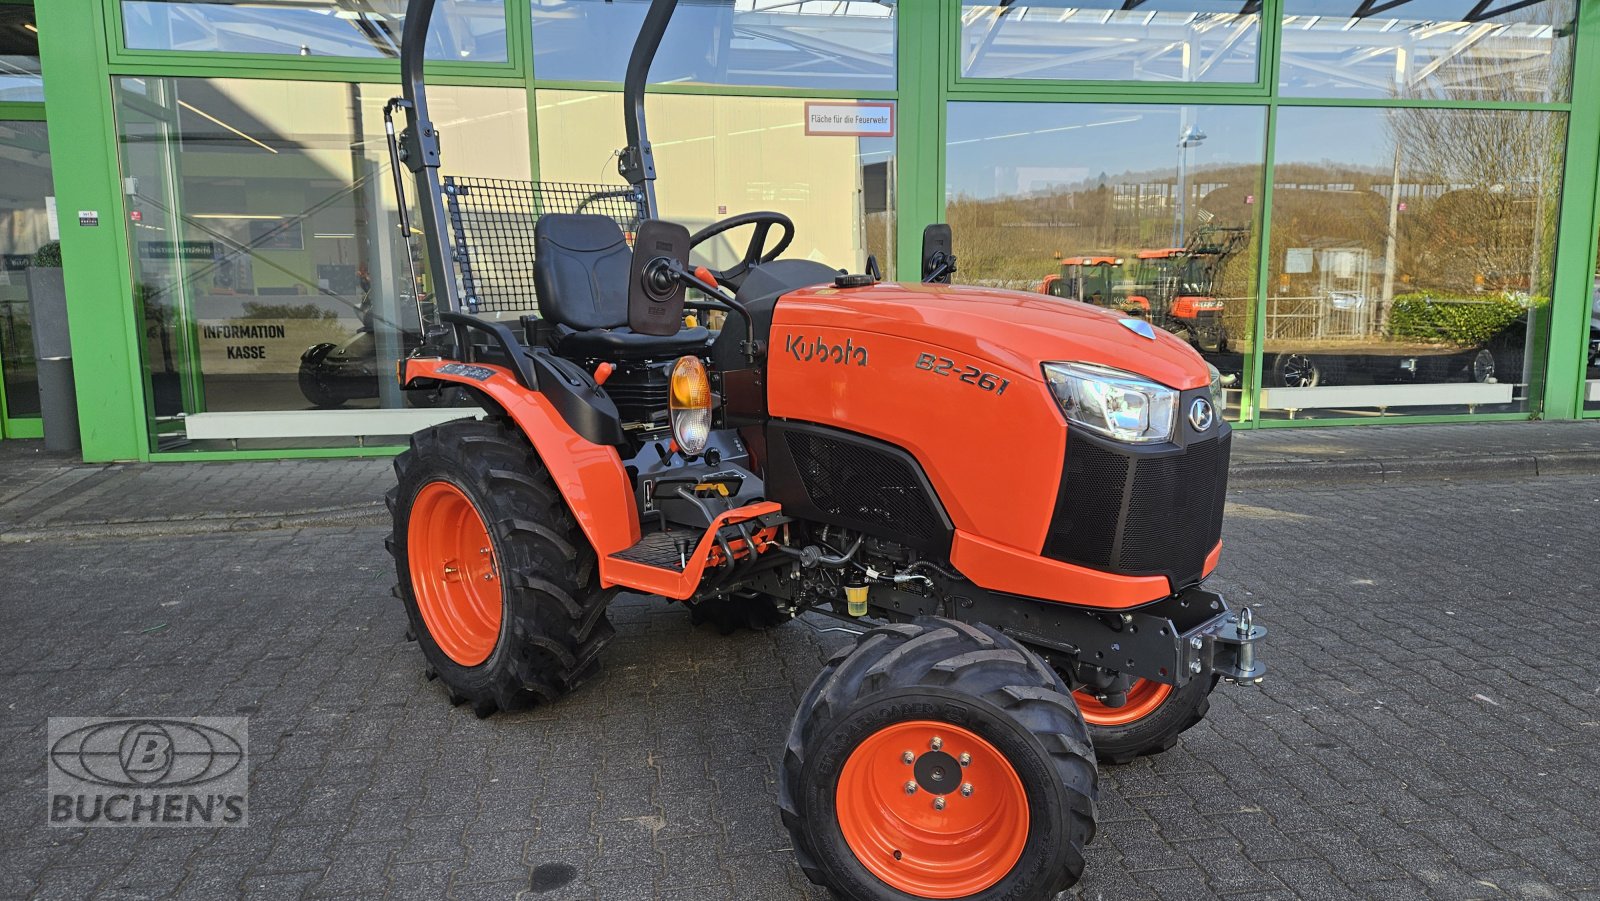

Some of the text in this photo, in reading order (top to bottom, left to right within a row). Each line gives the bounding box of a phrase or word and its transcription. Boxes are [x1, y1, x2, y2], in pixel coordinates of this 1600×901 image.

[811, 114, 888, 125] Fläche für die Feuerwehr
[203, 325, 285, 339] INFORMATION
[226, 345, 266, 360] KASSE
[786, 334, 868, 367] Kubota
[915, 352, 1010, 396] B2-261
